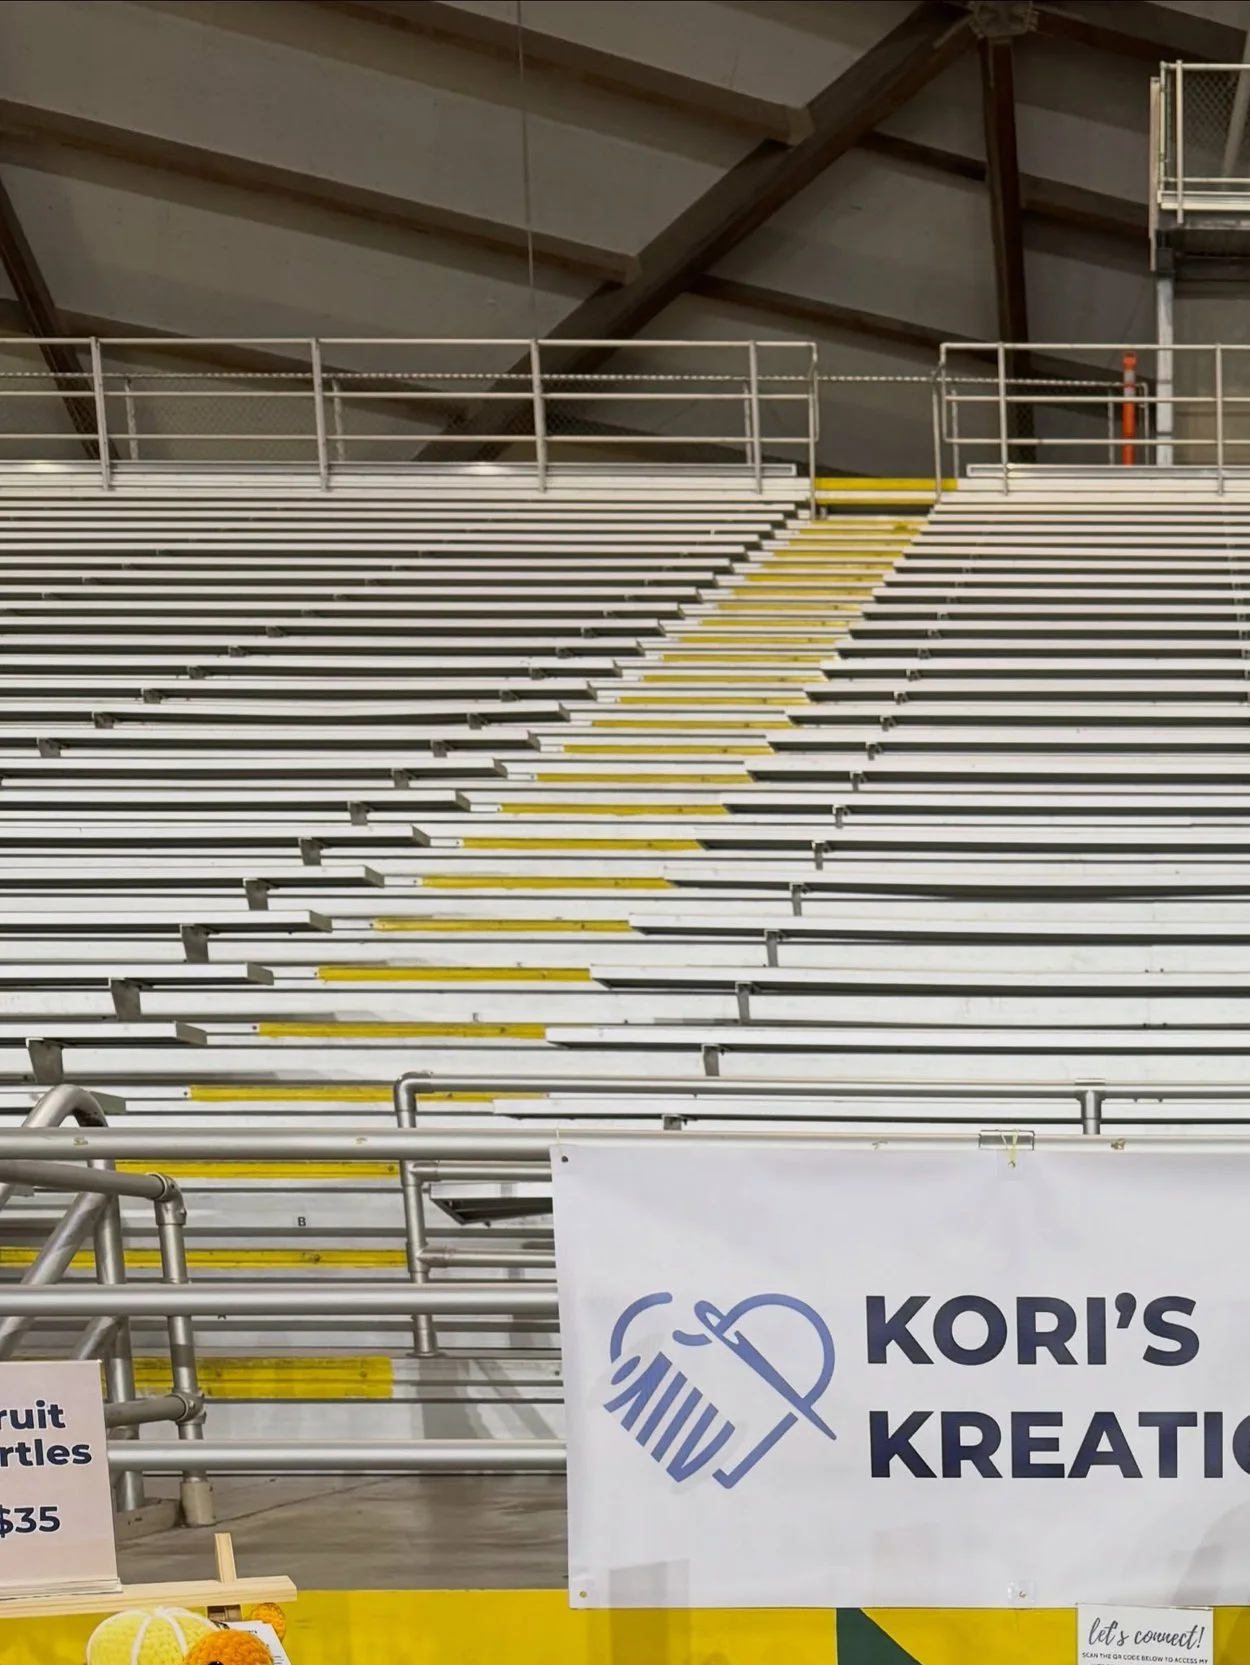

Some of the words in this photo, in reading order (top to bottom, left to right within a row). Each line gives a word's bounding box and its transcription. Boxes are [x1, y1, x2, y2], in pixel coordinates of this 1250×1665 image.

[298, 1216, 306, 1227] B
[865, 1293, 1199, 1367] KORI'S
[0, 1400, 66, 1430] ruit
[0, 1439, 92, 1467] rtles
[0, 1504, 61, 1538] $35
[1089, 1617, 1129, 1646] let's
[1134, 1625, 1205, 1649] connect!
